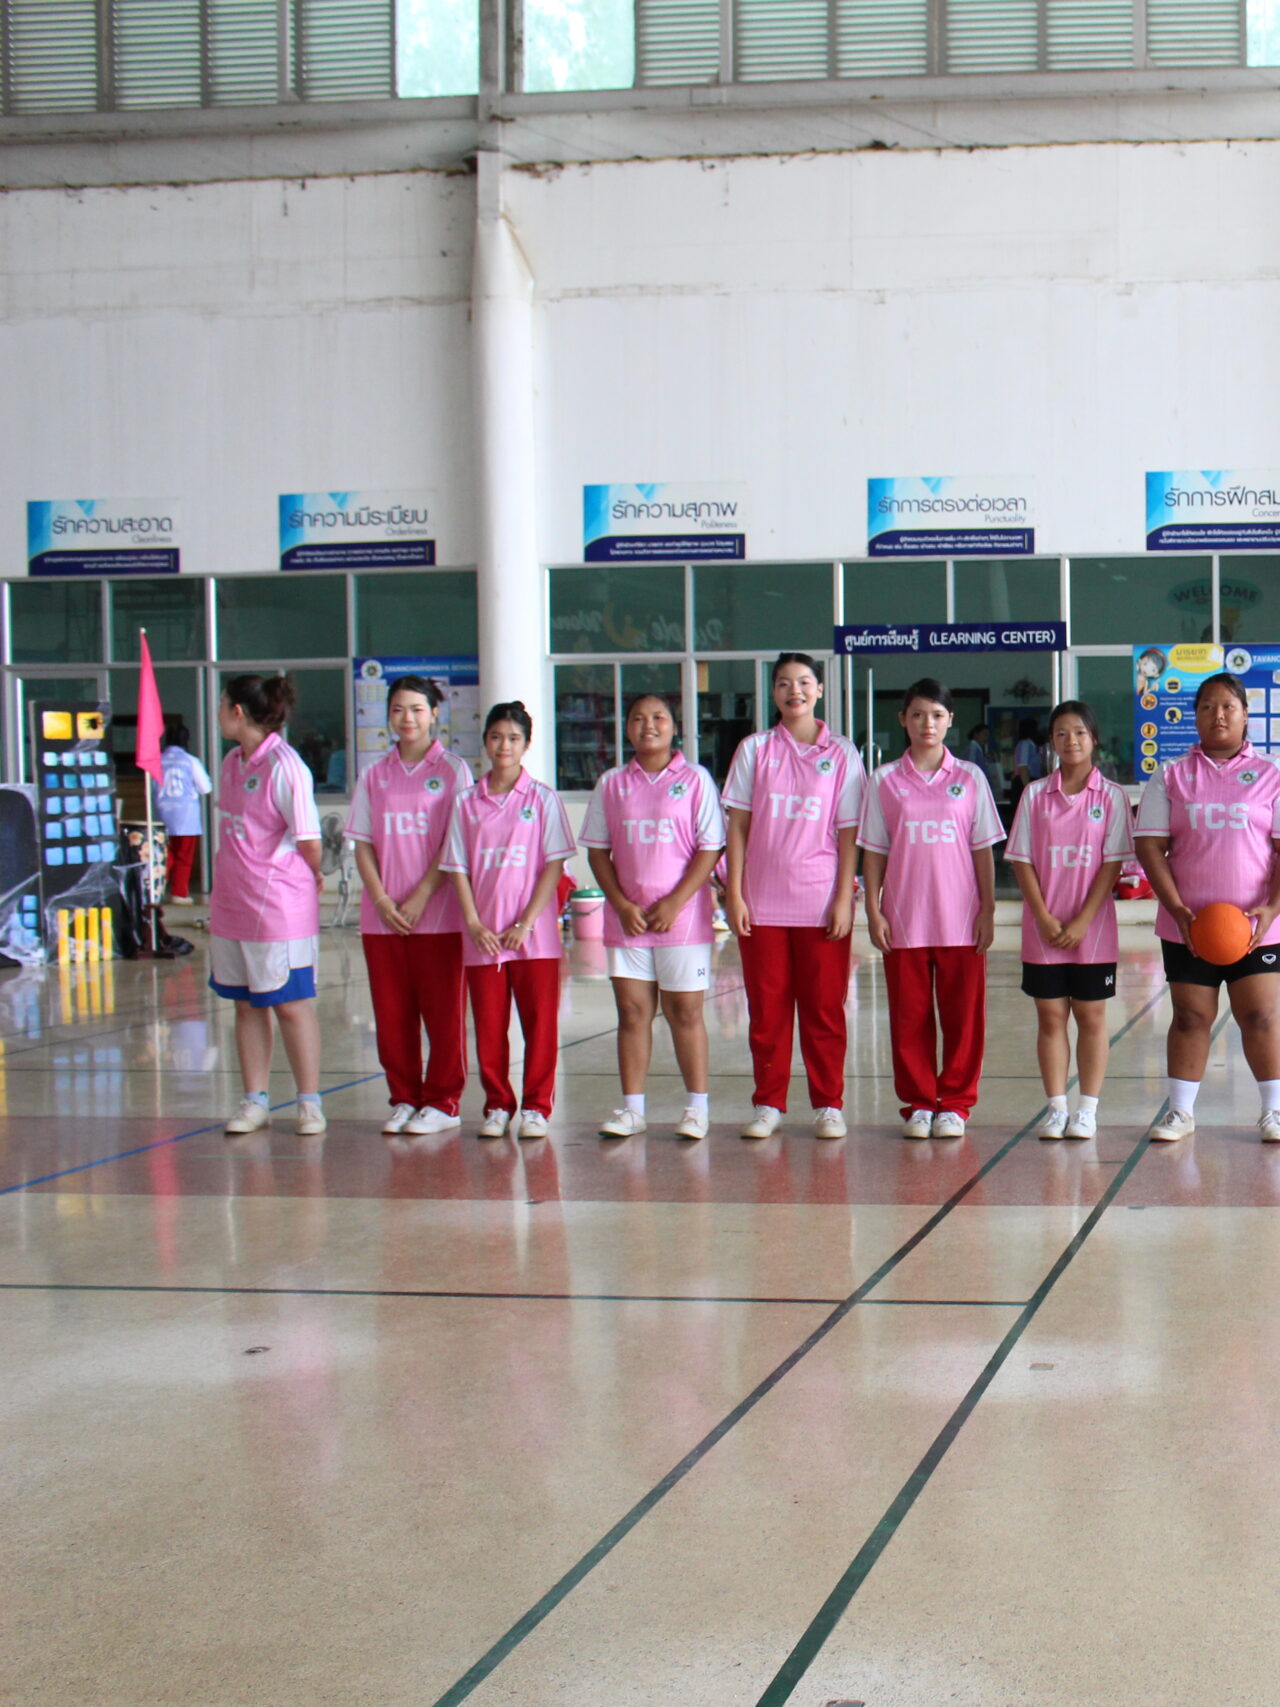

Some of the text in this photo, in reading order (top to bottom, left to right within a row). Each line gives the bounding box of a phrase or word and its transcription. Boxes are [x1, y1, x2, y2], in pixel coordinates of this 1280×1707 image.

[612, 500, 738, 523] รักความสุภาพ
[878, 494, 1027, 513] รักการตรงต่อเวลา
[52, 516, 173, 534] รักความสะอาด
[288, 505, 428, 528] รักความมีระเบียบ
[985, 514, 1026, 523] Punctuality
[1173, 584, 1258, 603] WELOME
[844, 629, 1056, 650] ศูนย์การเรียนรู้ (LEARNING CENTER)
[769, 793, 822, 821] TCS
[1184, 802, 1249, 830] TCS
[383, 812, 429, 835] TCS
[622, 819, 674, 844] TCS
[904, 820, 958, 844] TCS
[480, 845, 527, 869] TCS
[1048, 845, 1092, 868] TCS
